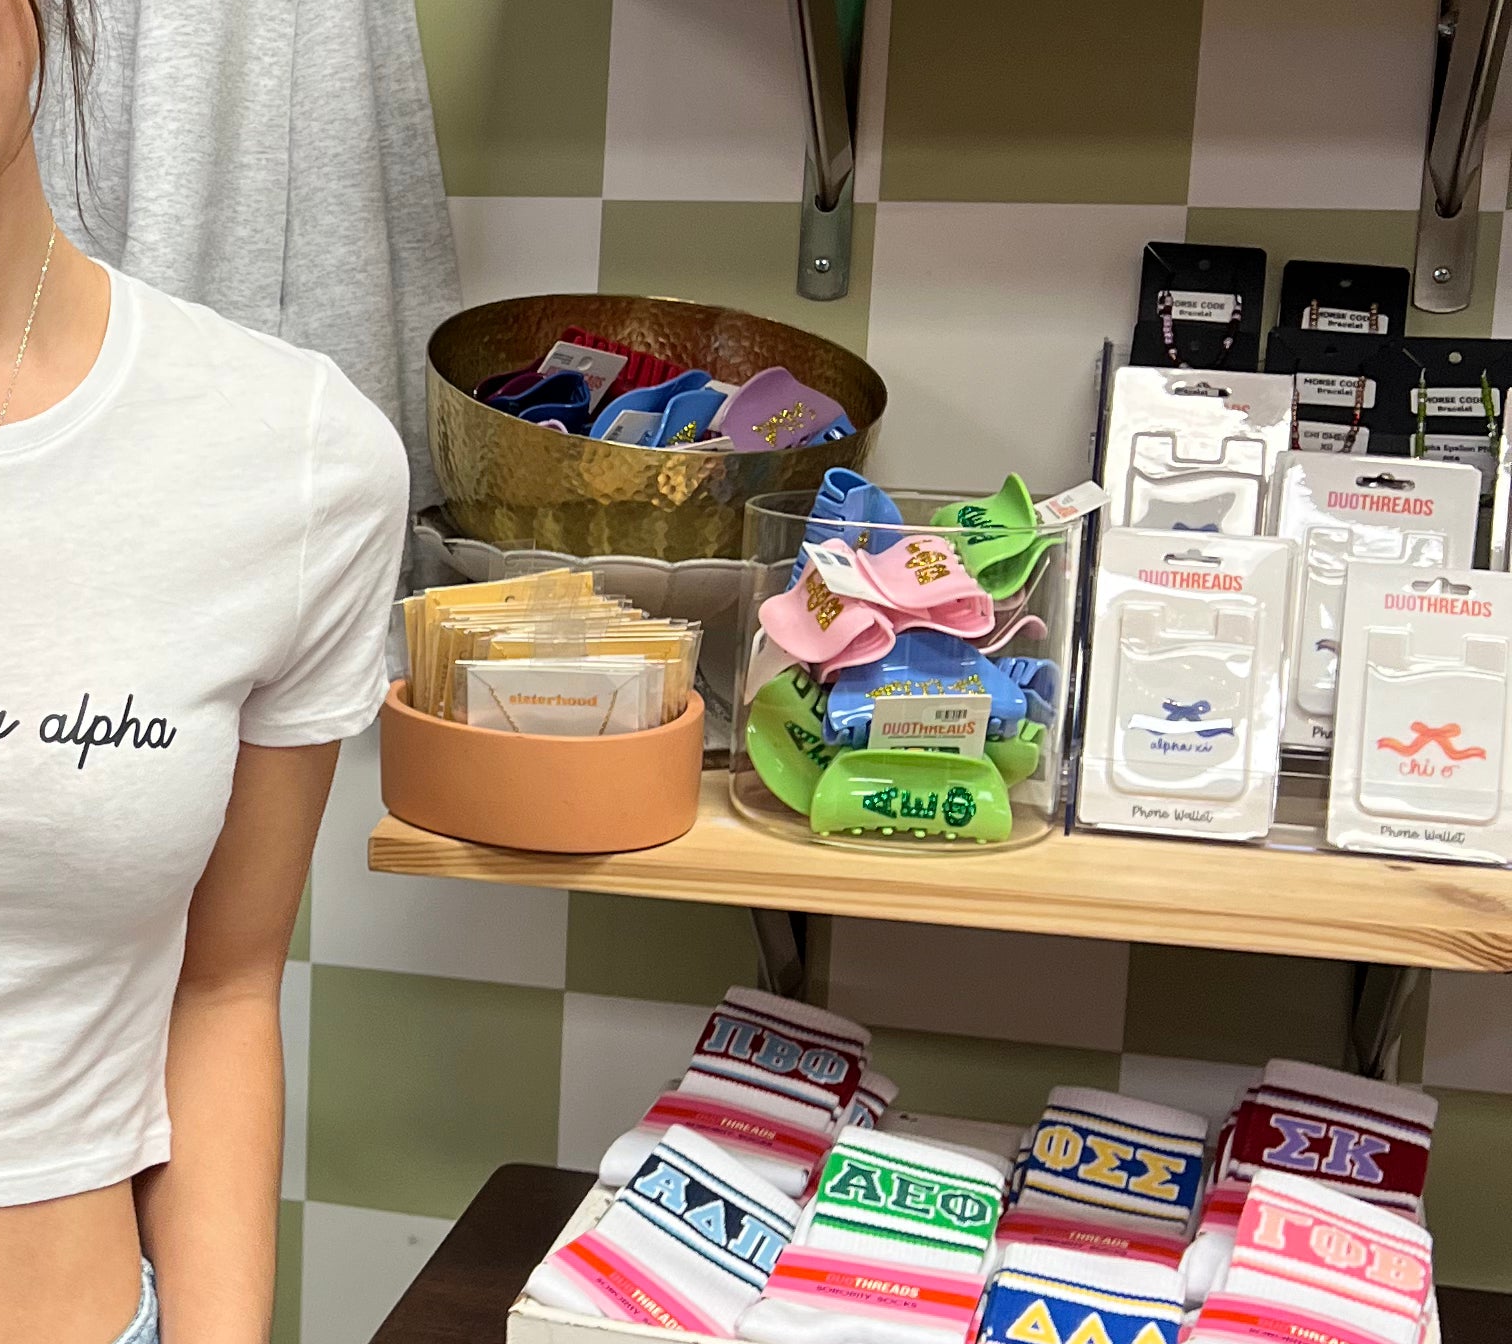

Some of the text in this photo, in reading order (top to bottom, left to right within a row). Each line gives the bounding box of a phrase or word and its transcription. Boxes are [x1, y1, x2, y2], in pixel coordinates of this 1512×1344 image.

[1170, 301, 1199, 311] ORSE
[1327, 319, 1364, 330] Bracelet
[1303, 377, 1360, 389] MORSE COD
[1317, 387, 1354, 397] Bracelet
[1437, 405, 1473, 413] Bracelet
[1327, 490, 1435, 517] DUOTHREADS
[1384, 593, 1493, 618] DUOTHREADS
[508, 693, 599, 707] sisterhood
[39, 692, 178, 769] alpha
[881, 721, 977, 736] DUOTHREADS
[1398, 758, 1435, 778] chi
[1131, 805, 1214, 823] Phone Wallet
[1380, 825, 1466, 845] Phone Wallet
[695, 1112, 777, 1143] THREADS
